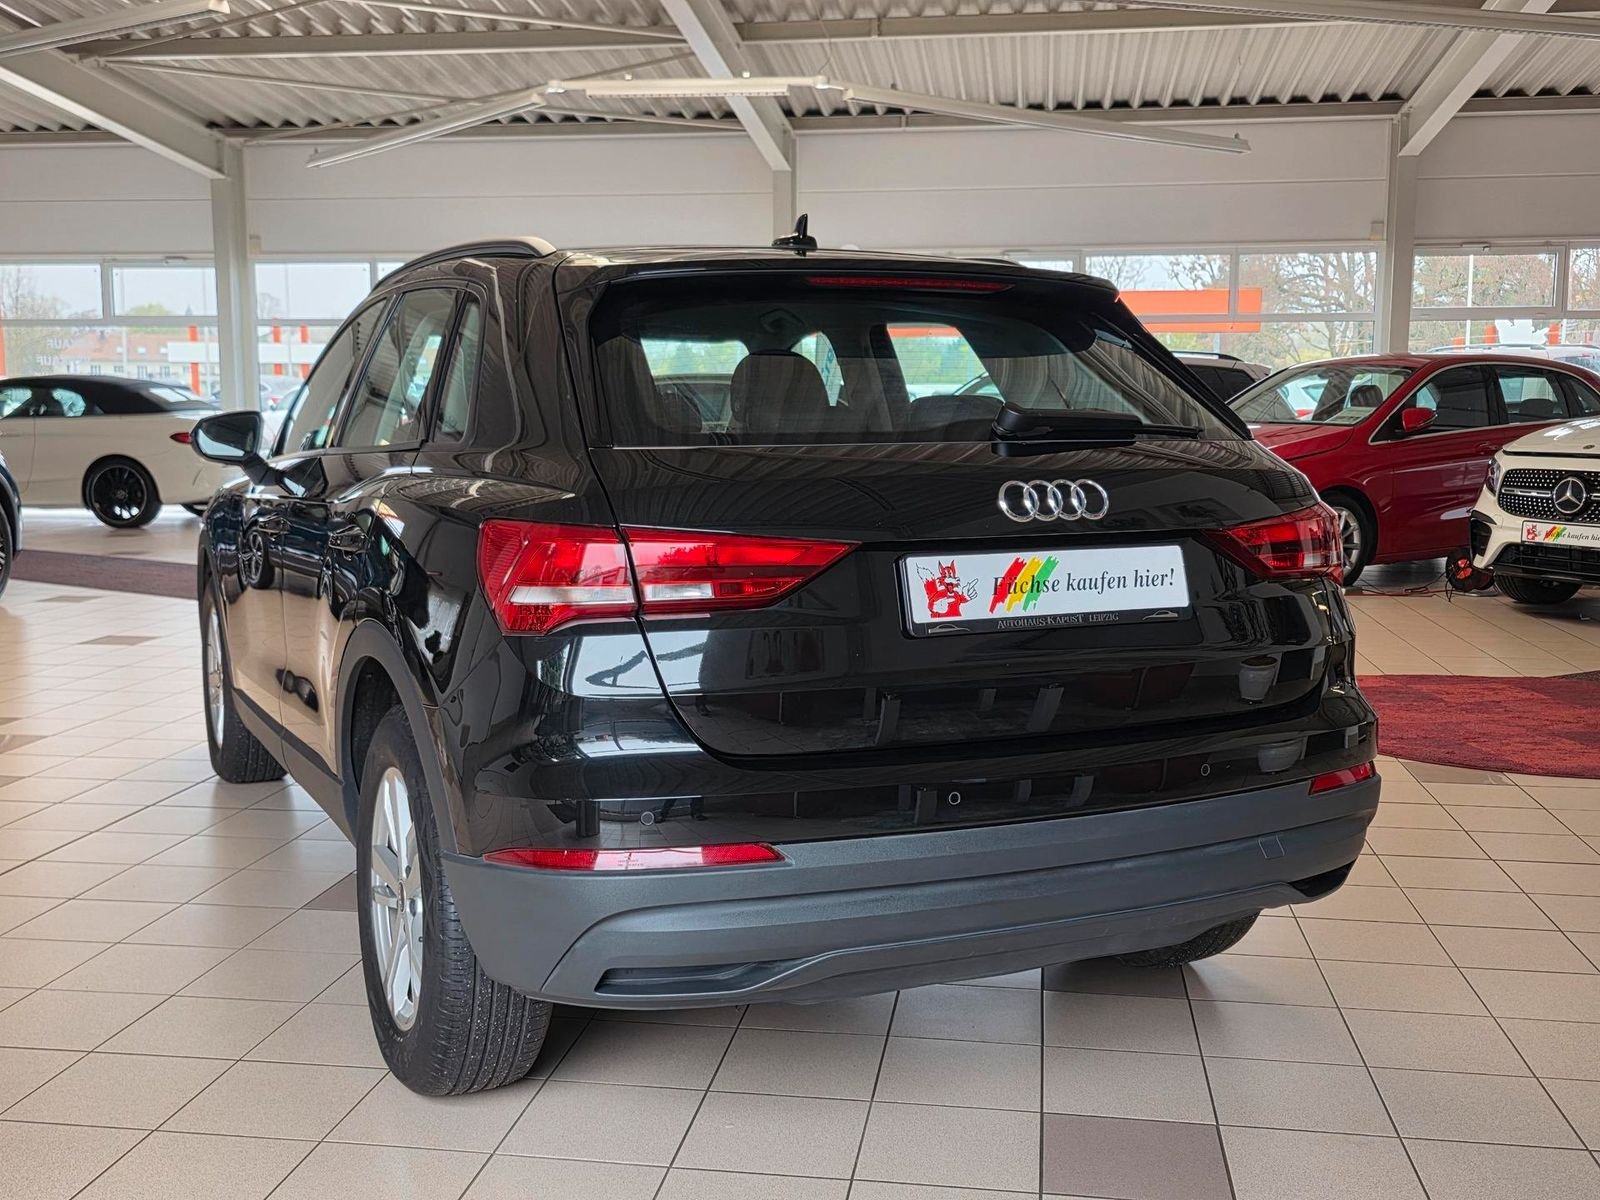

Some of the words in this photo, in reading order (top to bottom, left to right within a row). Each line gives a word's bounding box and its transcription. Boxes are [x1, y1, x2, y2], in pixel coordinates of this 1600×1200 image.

[1567, 532, 1590, 542] kaufen
[992, 574, 1060, 596] Füchse
[1066, 571, 1128, 595] kaufen
[1133, 568, 1175, 588] hier!
[1089, 612, 1119, 623] LEIPZIG
